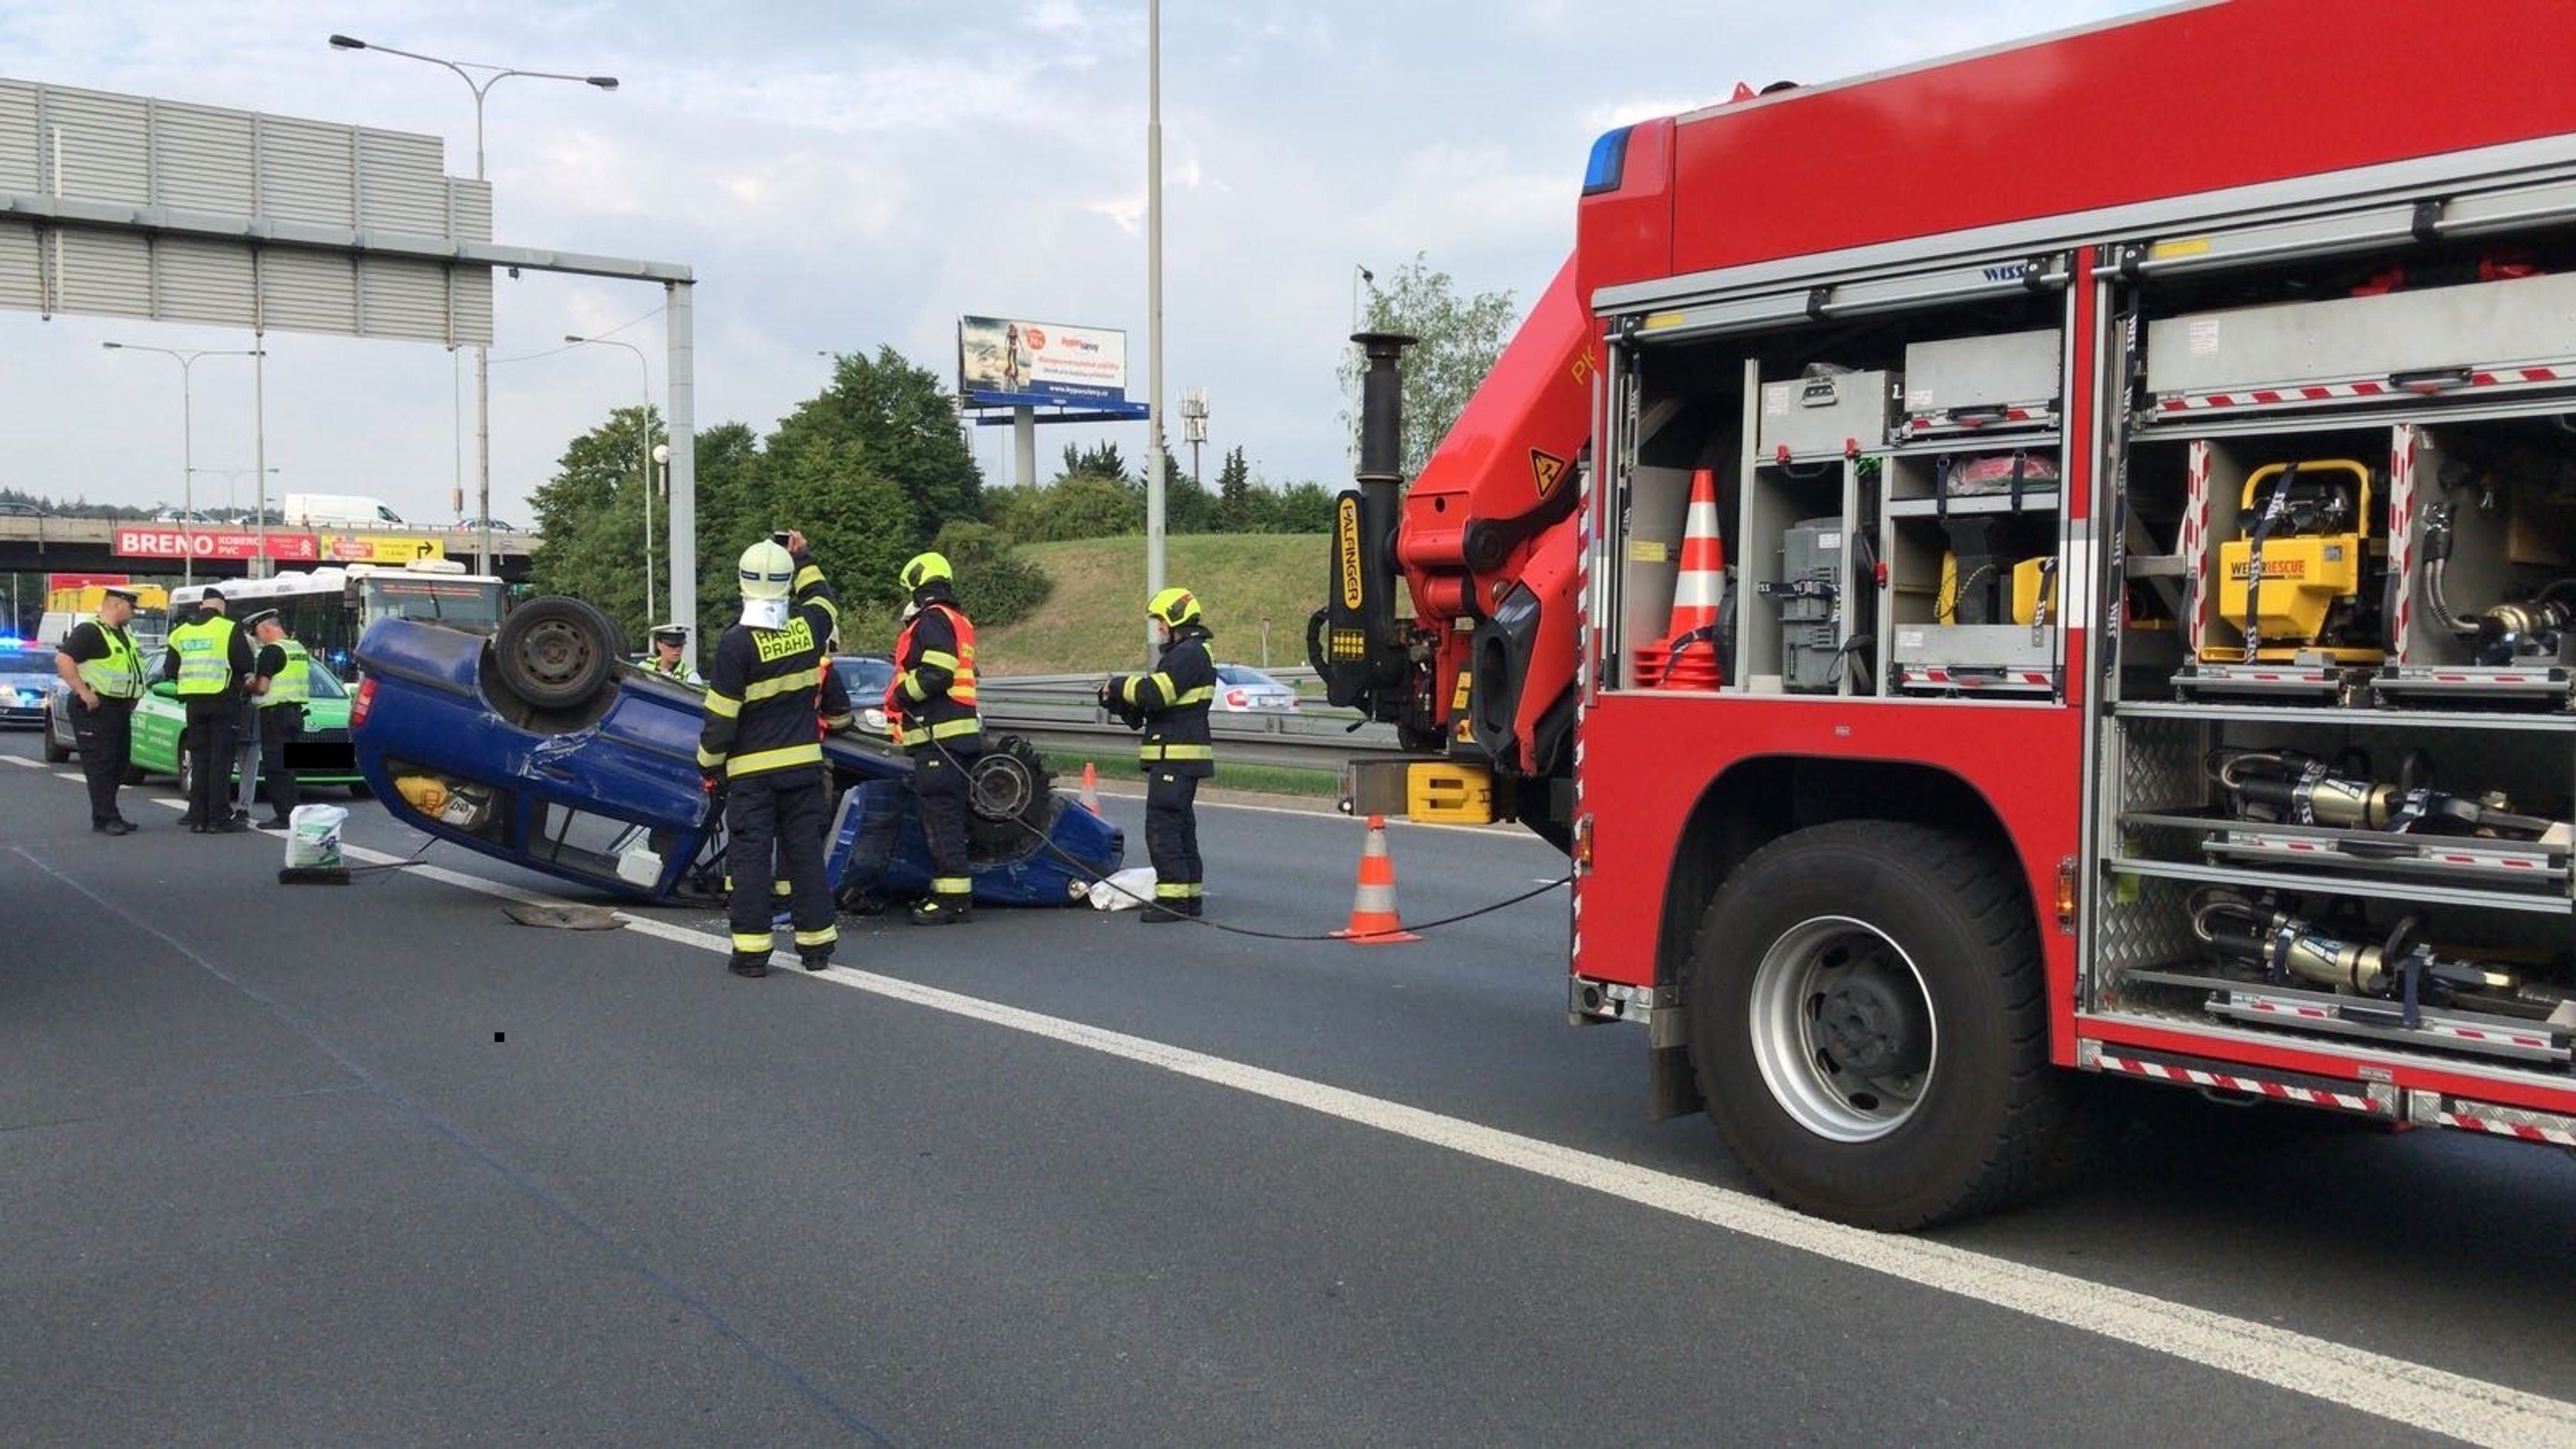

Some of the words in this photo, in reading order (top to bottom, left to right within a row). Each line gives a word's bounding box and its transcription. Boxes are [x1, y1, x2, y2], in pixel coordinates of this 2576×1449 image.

[1984, 266, 2024, 281] WISS
[122, 533, 214, 555] BRENO
[218, 546, 239, 555] PVC
[1343, 505, 1359, 601] PALFINGER
[762, 636, 811, 660] PRAHA
